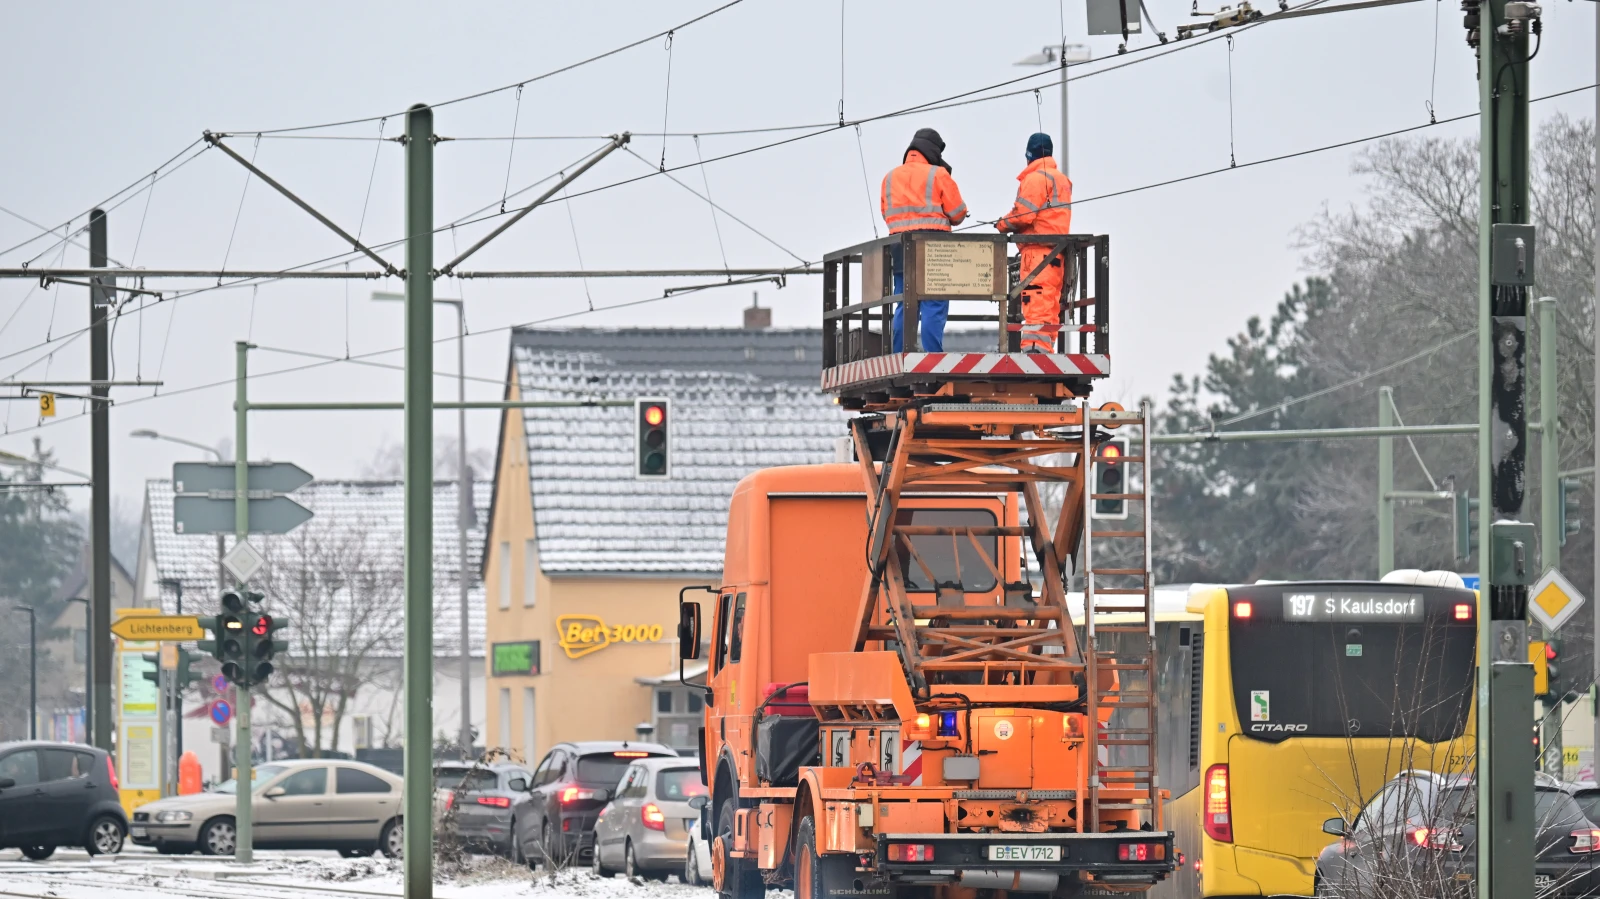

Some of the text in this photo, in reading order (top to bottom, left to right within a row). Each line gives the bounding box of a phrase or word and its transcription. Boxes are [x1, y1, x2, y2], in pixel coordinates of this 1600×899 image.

[1289, 595, 1416, 615] 197 S Kaulsdorf
[130, 624, 193, 635] Lichtenberg
[1031, 847, 1053, 859] 1712
